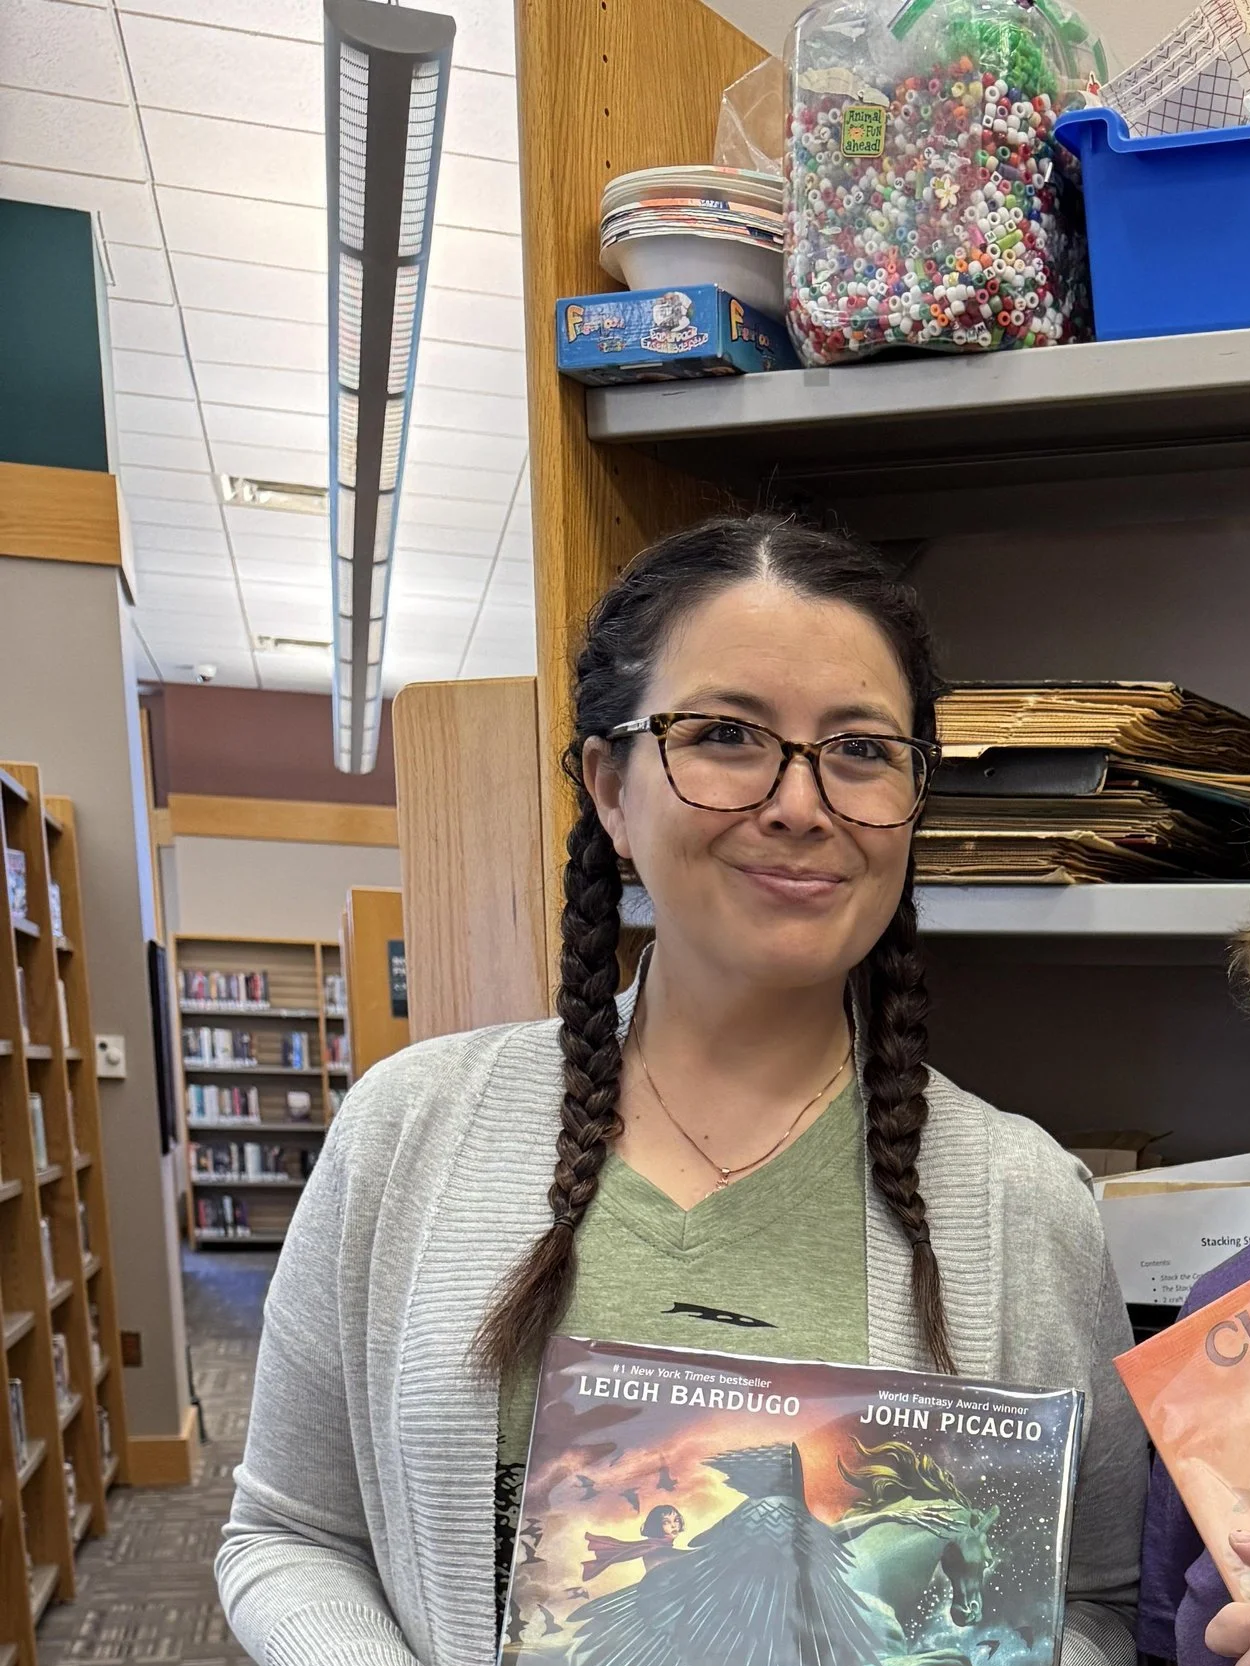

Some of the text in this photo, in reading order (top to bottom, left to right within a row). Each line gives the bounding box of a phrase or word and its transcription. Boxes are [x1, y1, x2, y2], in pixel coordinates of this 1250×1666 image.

[1201, 1236, 1242, 1247] Stacking
[612, 1364, 772, 1389] #1 New York Times bestseller
[579, 1376, 800, 1416] LEIGH BARDUGO
[878, 1390, 1029, 1415] World Fantasy Award winner
[860, 1404, 1042, 1441] JOHN PICACIO
